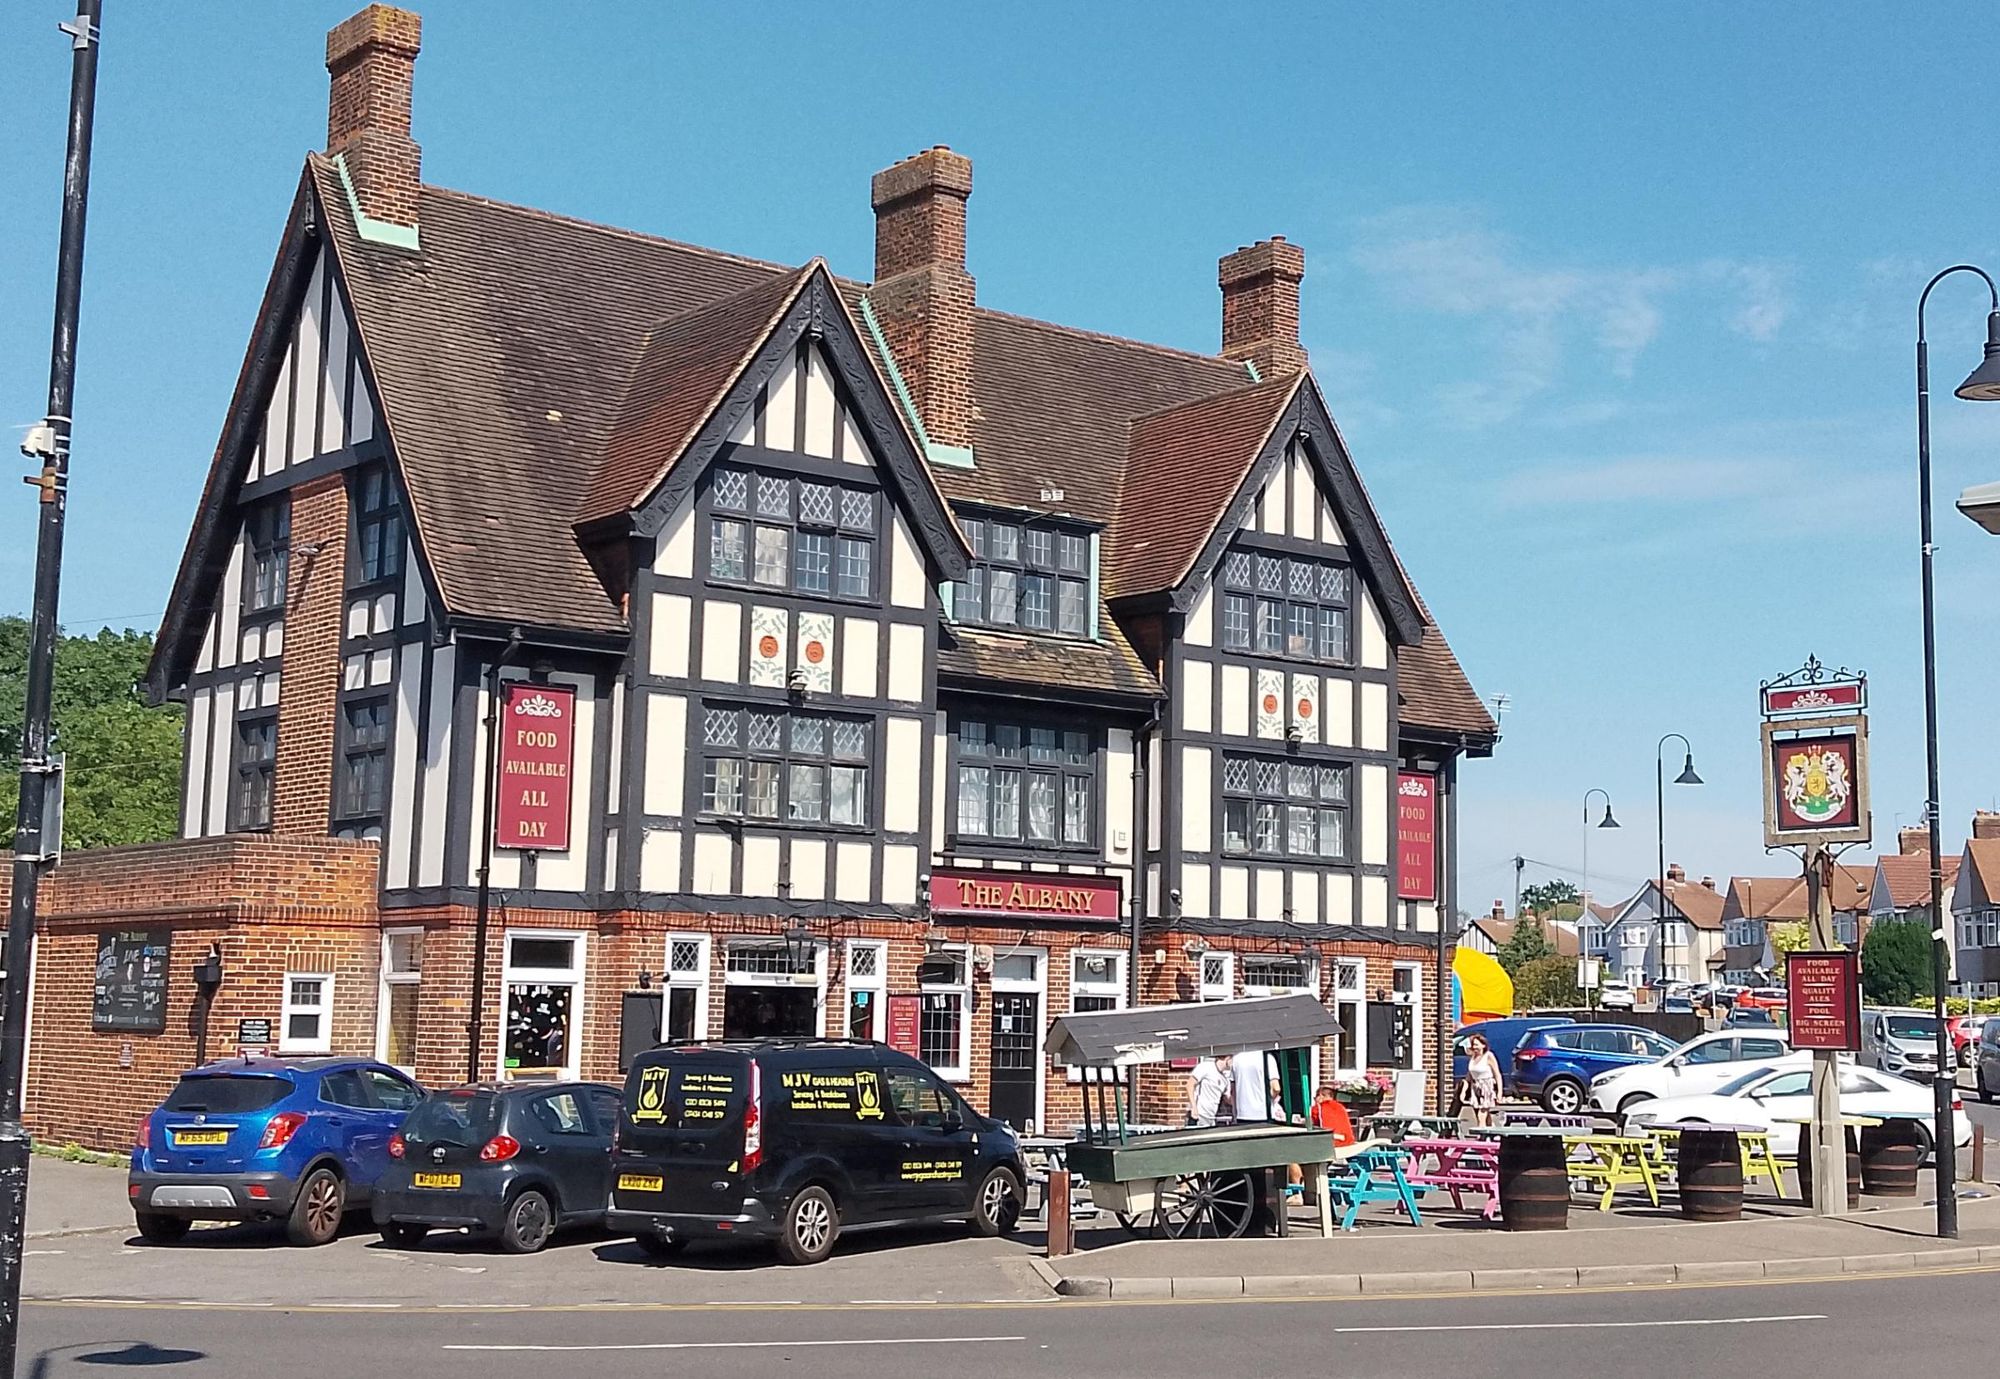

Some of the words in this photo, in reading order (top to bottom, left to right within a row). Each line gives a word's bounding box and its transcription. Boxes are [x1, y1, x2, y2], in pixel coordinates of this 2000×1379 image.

[516, 730, 557, 748] FOOD
[505, 760, 567, 777] AVAILABLE
[520, 790, 549, 807] ALL
[1400, 806, 1425, 820] FOOD
[518, 821, 548, 838] DAY
[1404, 853, 1421, 866] ALL
[1404, 876, 1422, 890] DAY
[957, 879, 1004, 907] THE
[1006, 882, 1095, 913] ALBANY
[782, 1073, 811, 1087] MJV
